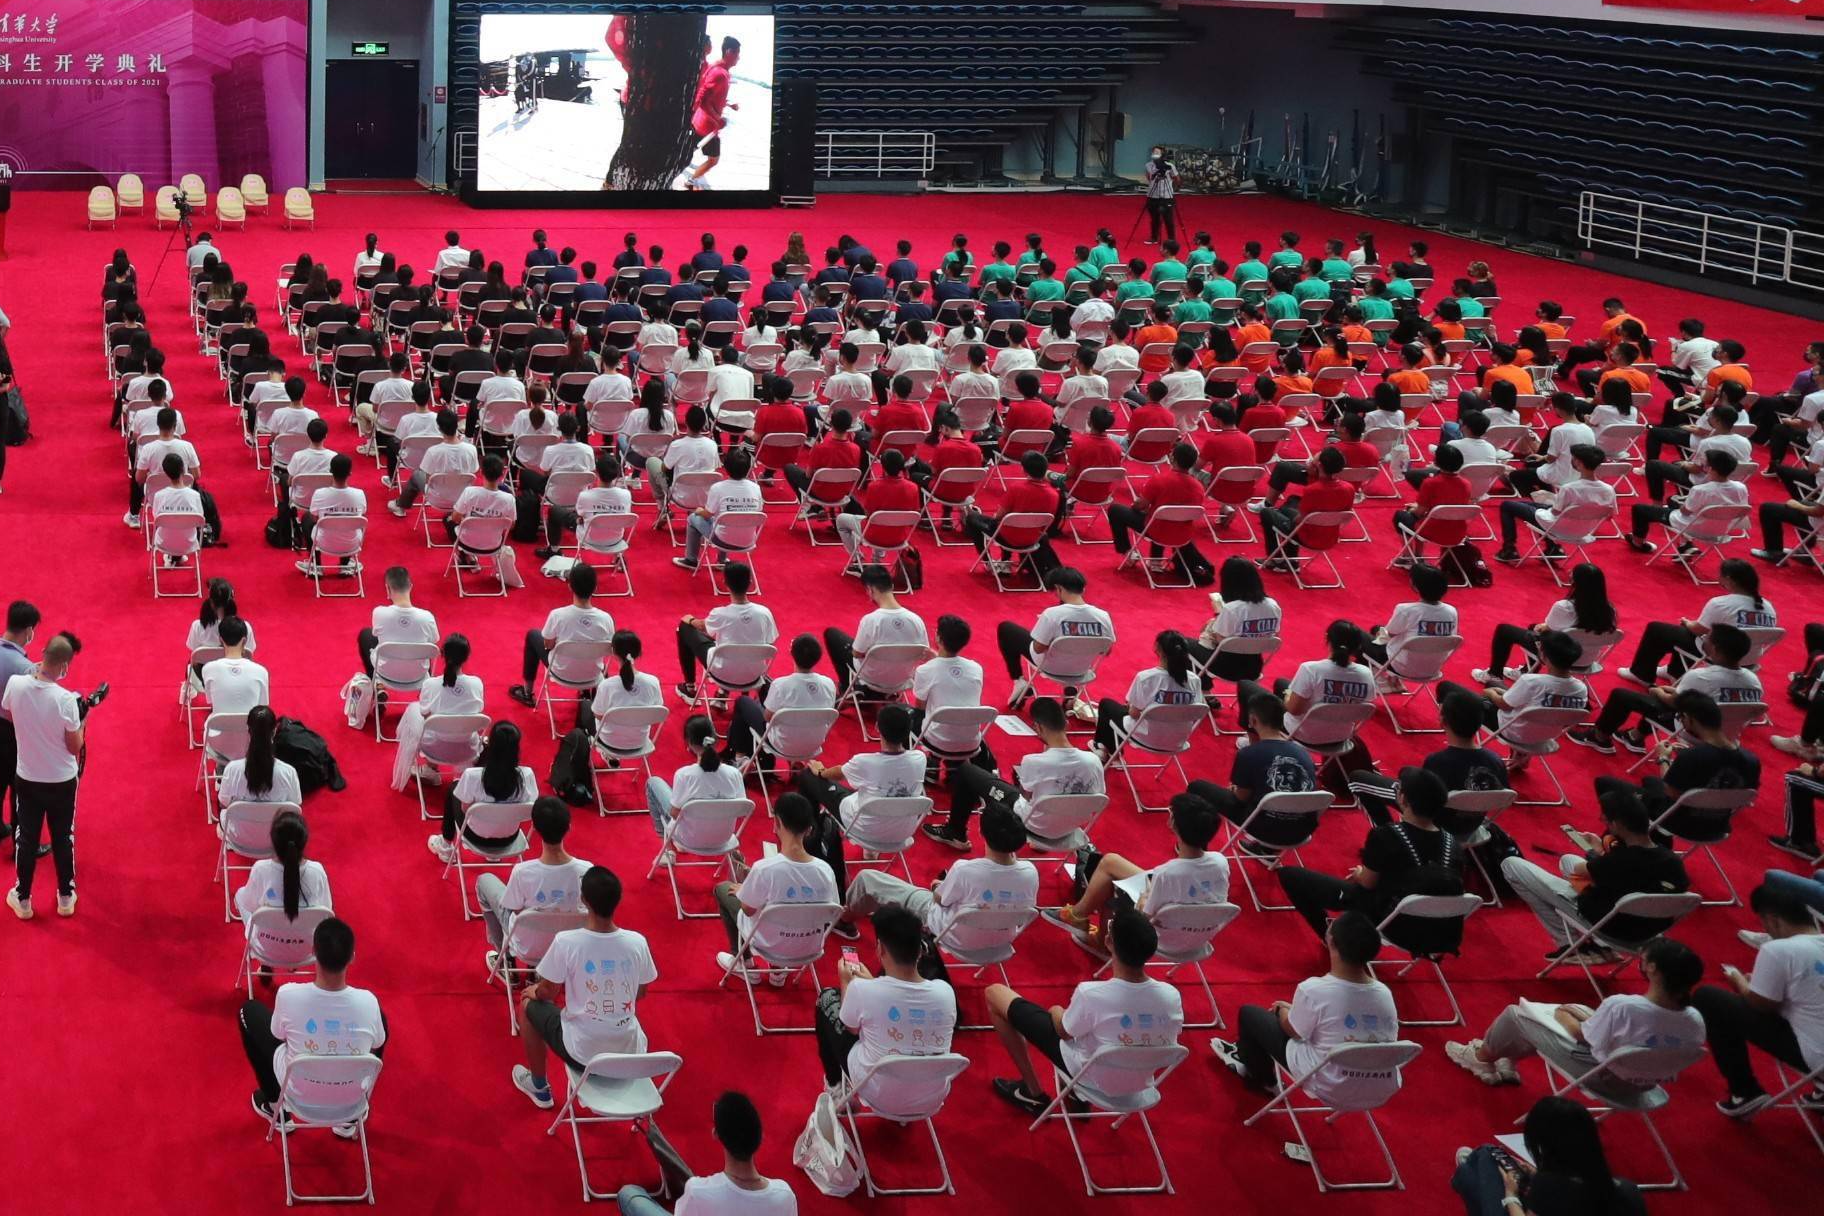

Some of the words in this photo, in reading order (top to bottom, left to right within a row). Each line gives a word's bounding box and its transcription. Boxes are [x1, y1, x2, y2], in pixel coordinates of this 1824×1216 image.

[25, 35, 57, 44] University
[141, 78, 161, 86] 2021
[1063, 621, 1102, 636] SOCIAL
[1243, 619, 1279, 634] SOCIAL
[1324, 679, 1367, 697] SOCIAL
